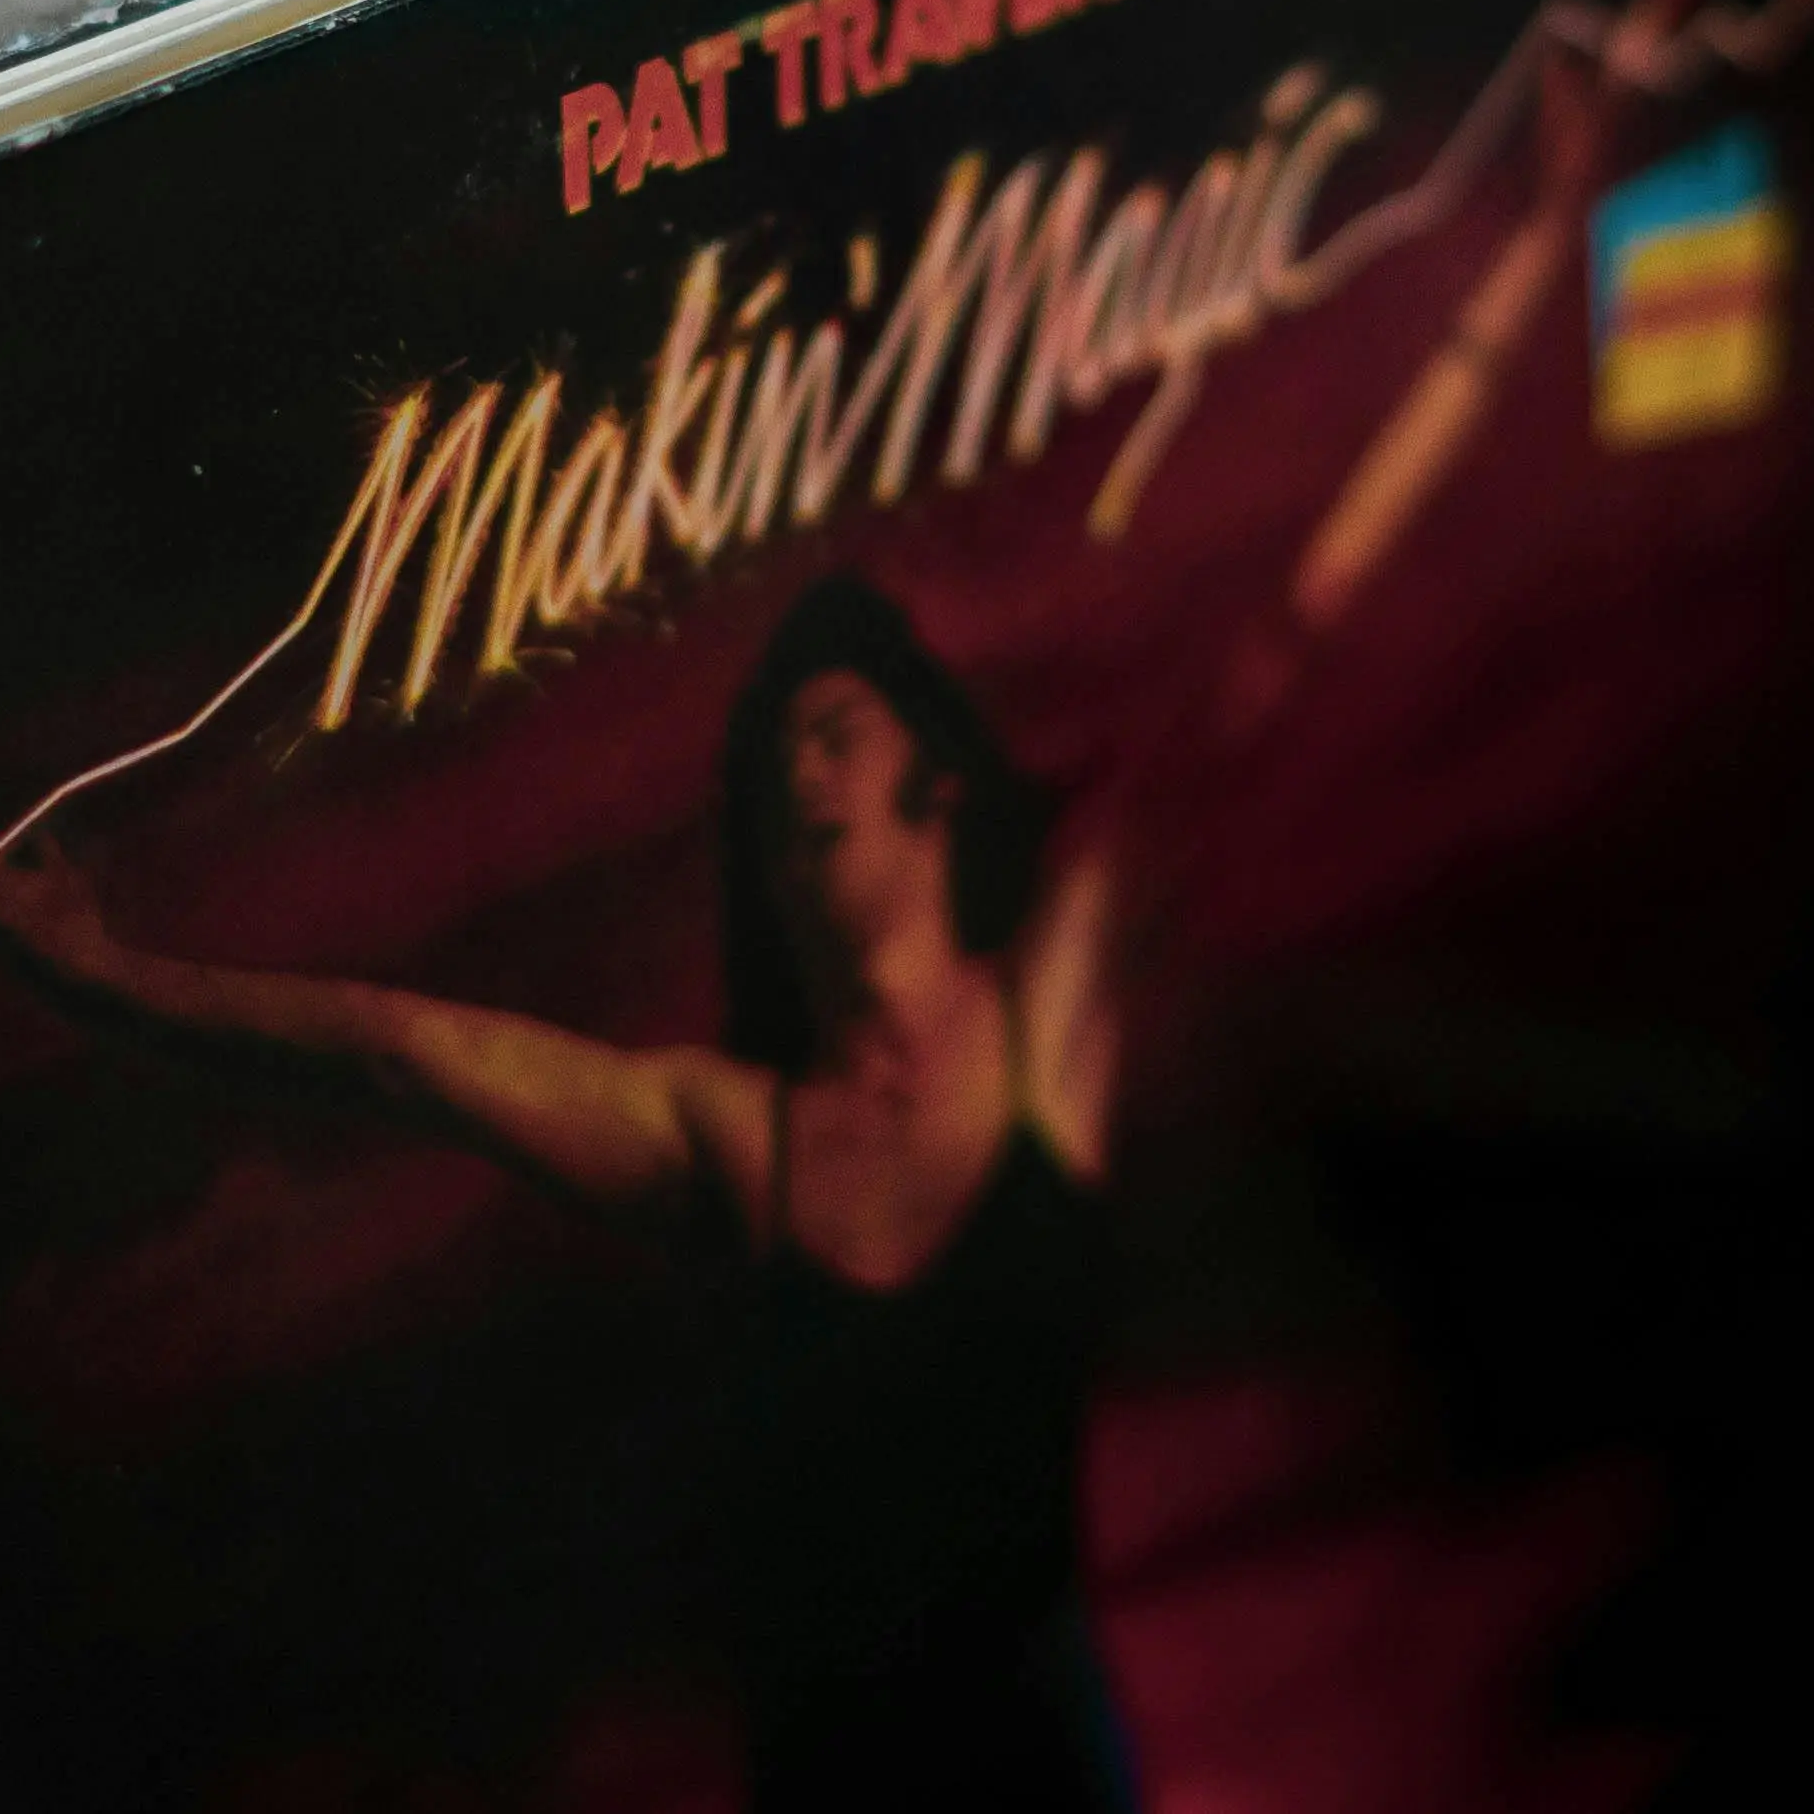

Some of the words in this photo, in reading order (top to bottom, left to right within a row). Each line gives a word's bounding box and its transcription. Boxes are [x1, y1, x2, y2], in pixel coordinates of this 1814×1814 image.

[560, 29, 743, 216] PAT
[296, 236, 878, 732] Makin'
[866, 58, 1381, 544] Magic
